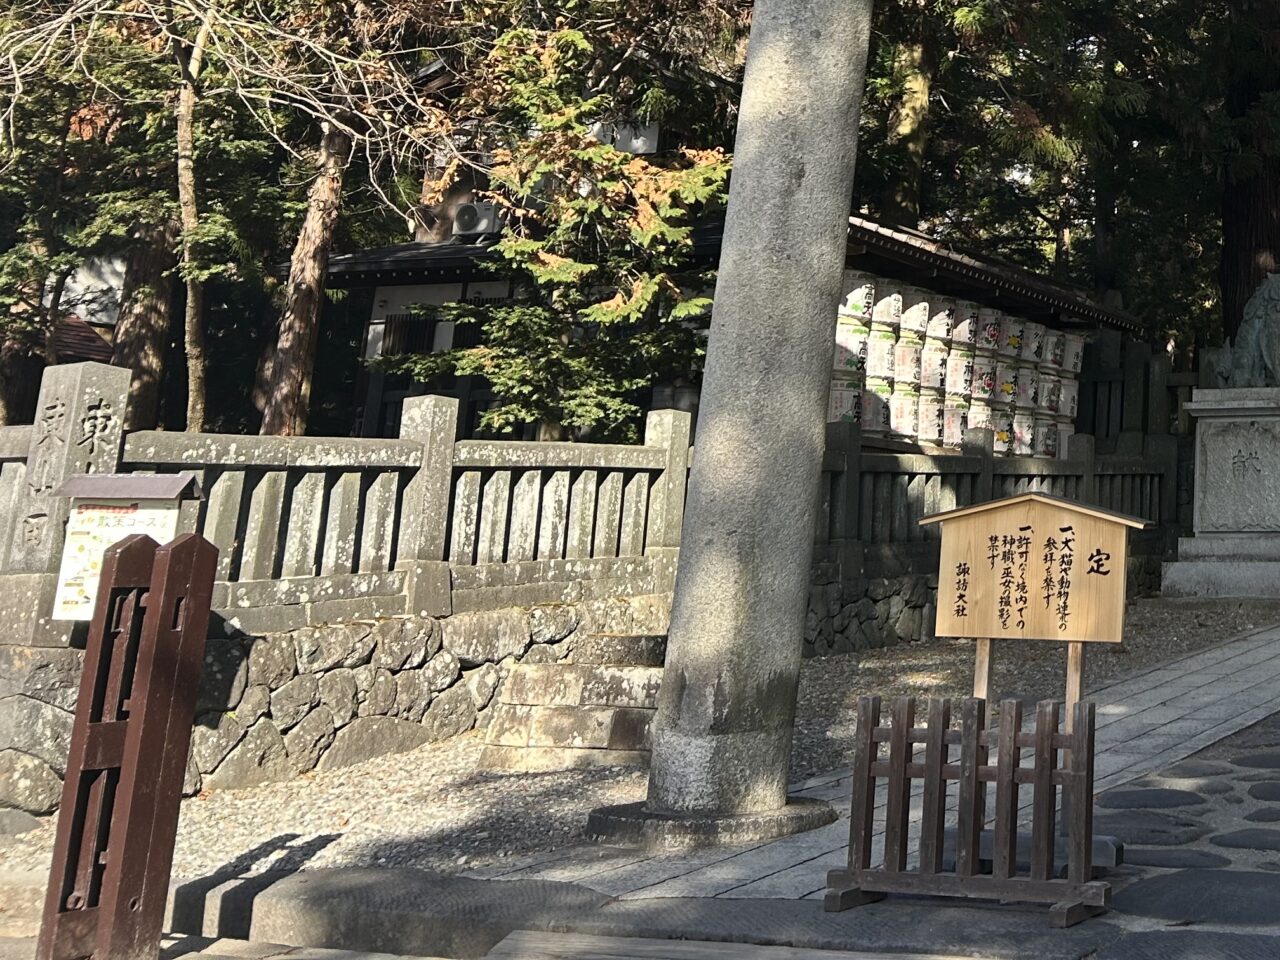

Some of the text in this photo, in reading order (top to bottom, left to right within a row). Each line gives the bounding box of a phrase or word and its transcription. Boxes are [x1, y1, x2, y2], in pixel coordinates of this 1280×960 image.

[987, 535, 1000, 571] 禁ず
[1086, 548, 1111, 576] 定
[953, 562, 971, 618] 諏訪大社
